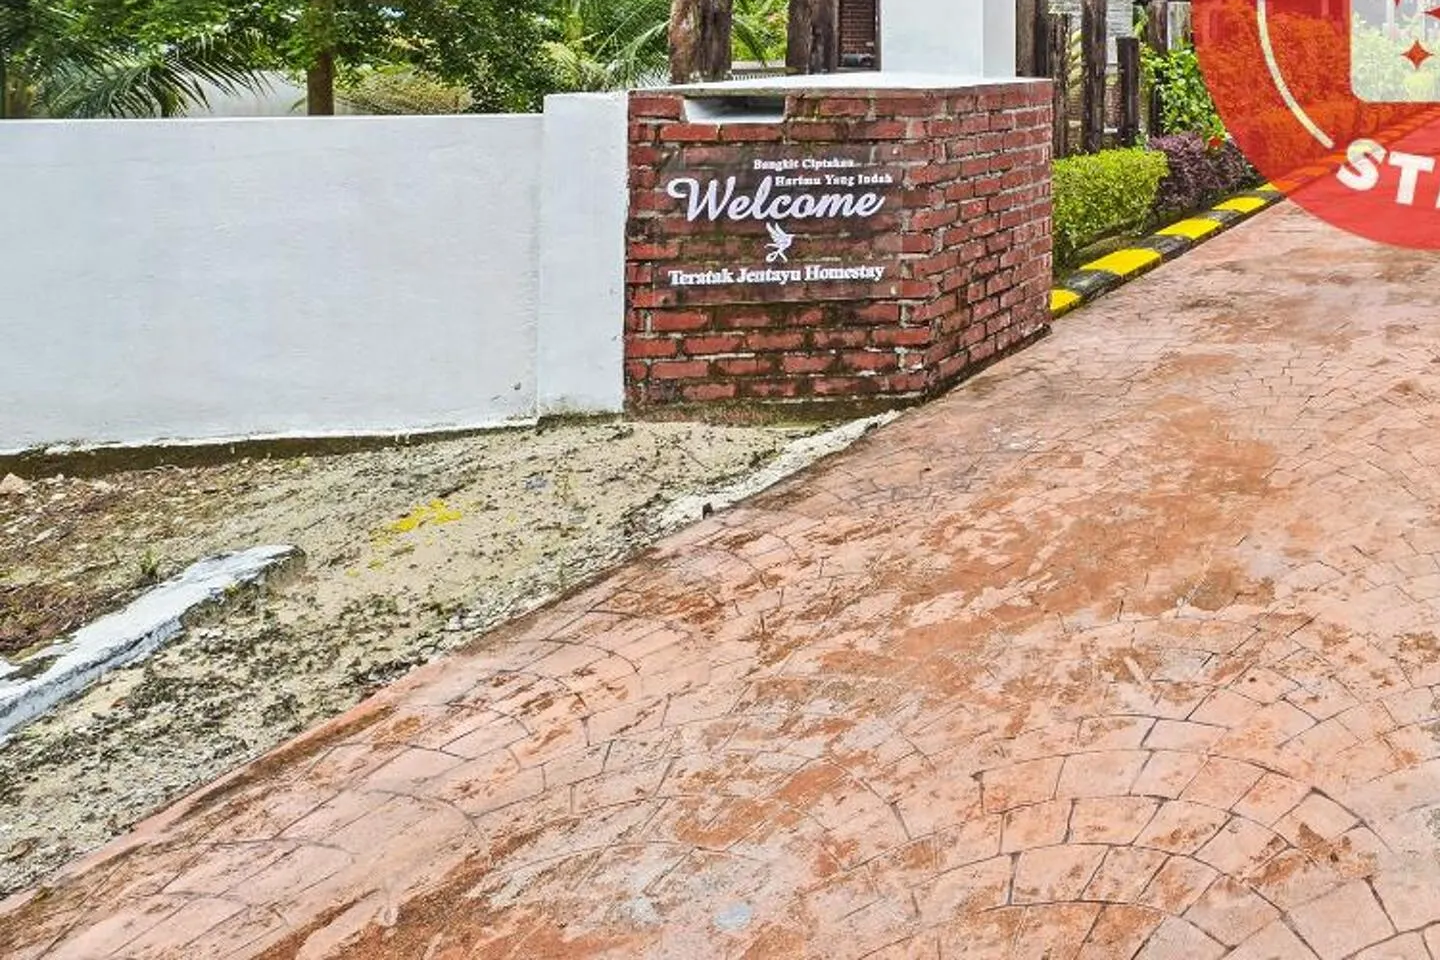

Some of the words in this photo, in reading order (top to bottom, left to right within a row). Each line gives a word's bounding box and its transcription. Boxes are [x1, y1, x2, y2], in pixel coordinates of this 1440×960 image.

[824, 174, 855, 186] Yang
[858, 174, 893, 185] Indah
[667, 175, 886, 222] Welcome
[668, 269, 734, 286] Teratak
[736, 268, 801, 284] Jentayu
[804, 265, 885, 281] Homestay
